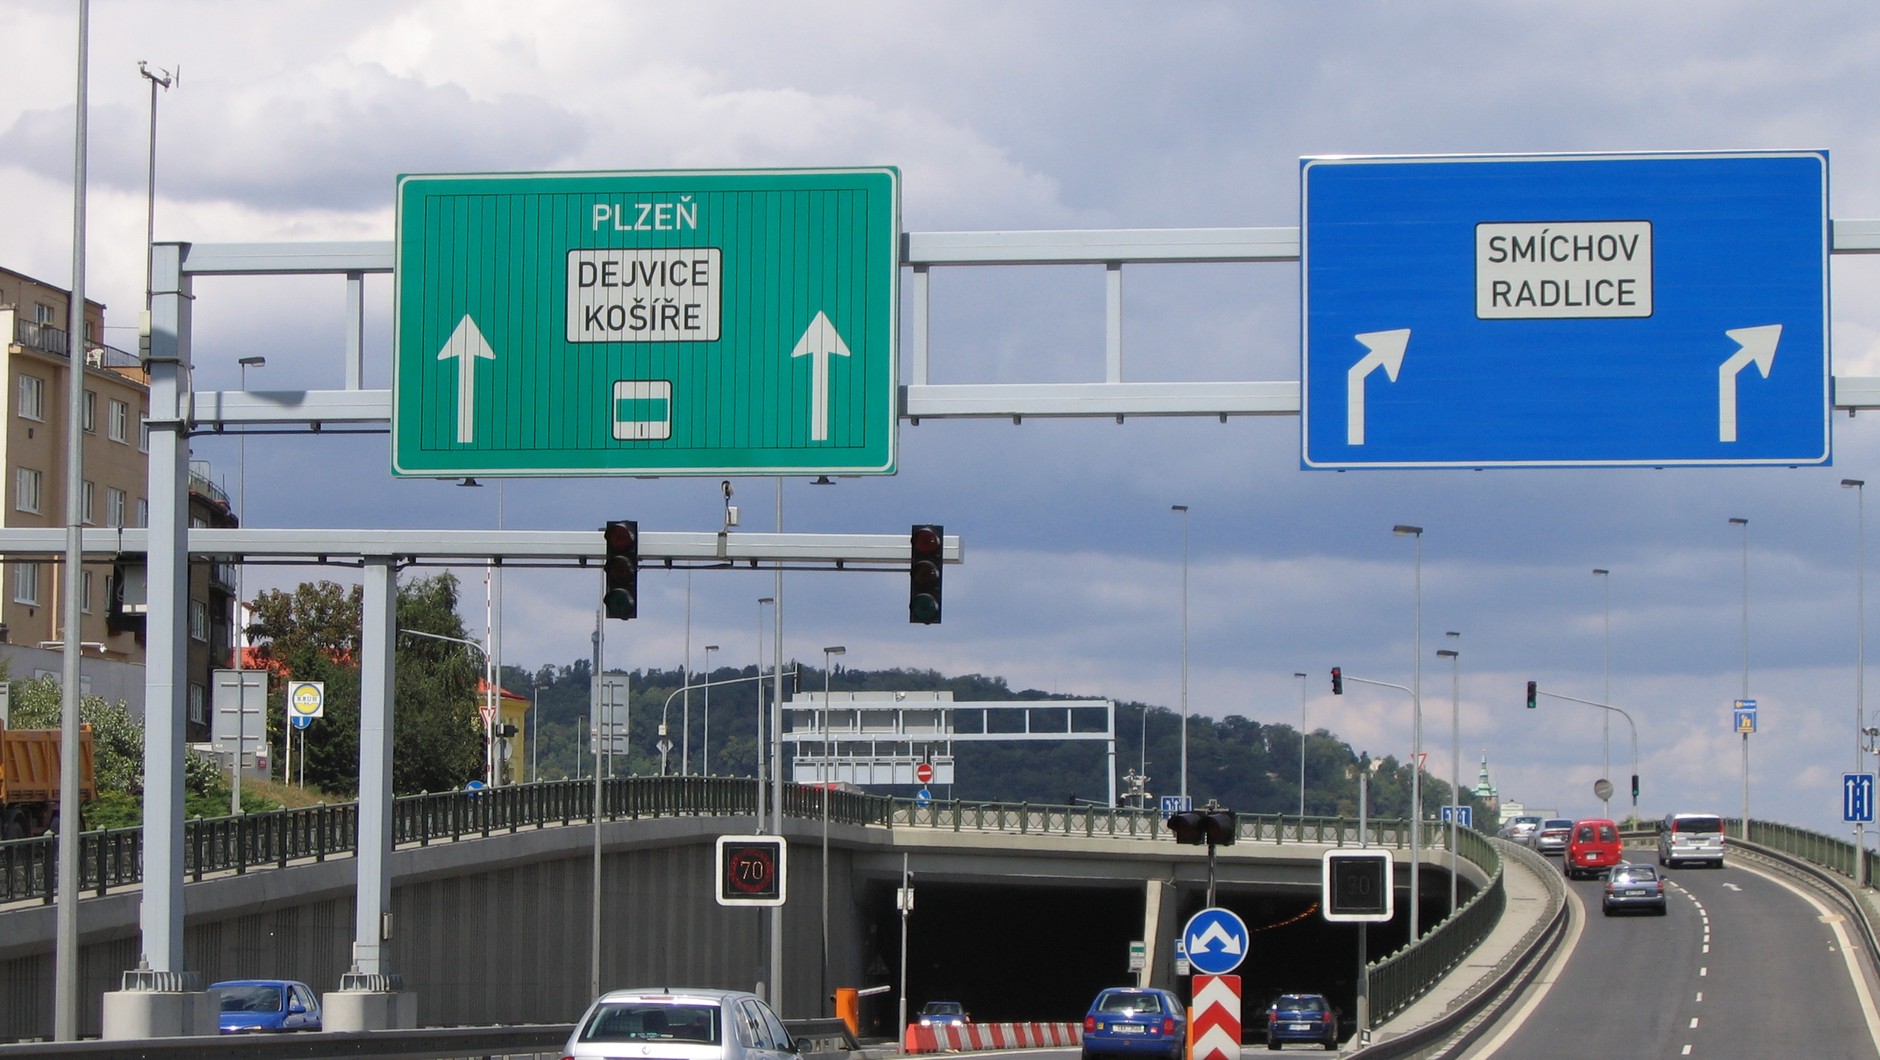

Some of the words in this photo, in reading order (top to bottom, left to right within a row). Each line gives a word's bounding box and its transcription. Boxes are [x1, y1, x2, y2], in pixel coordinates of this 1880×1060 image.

[592, 195, 698, 231] PLZEŇ
[1488, 228, 1639, 263] SMÍCHOV
[578, 260, 709, 288] DEJVICE
[1492, 279, 1636, 307] RADLICE
[585, 297, 702, 331] KOŠÍŘE
[740, 860, 763, 880] 70
